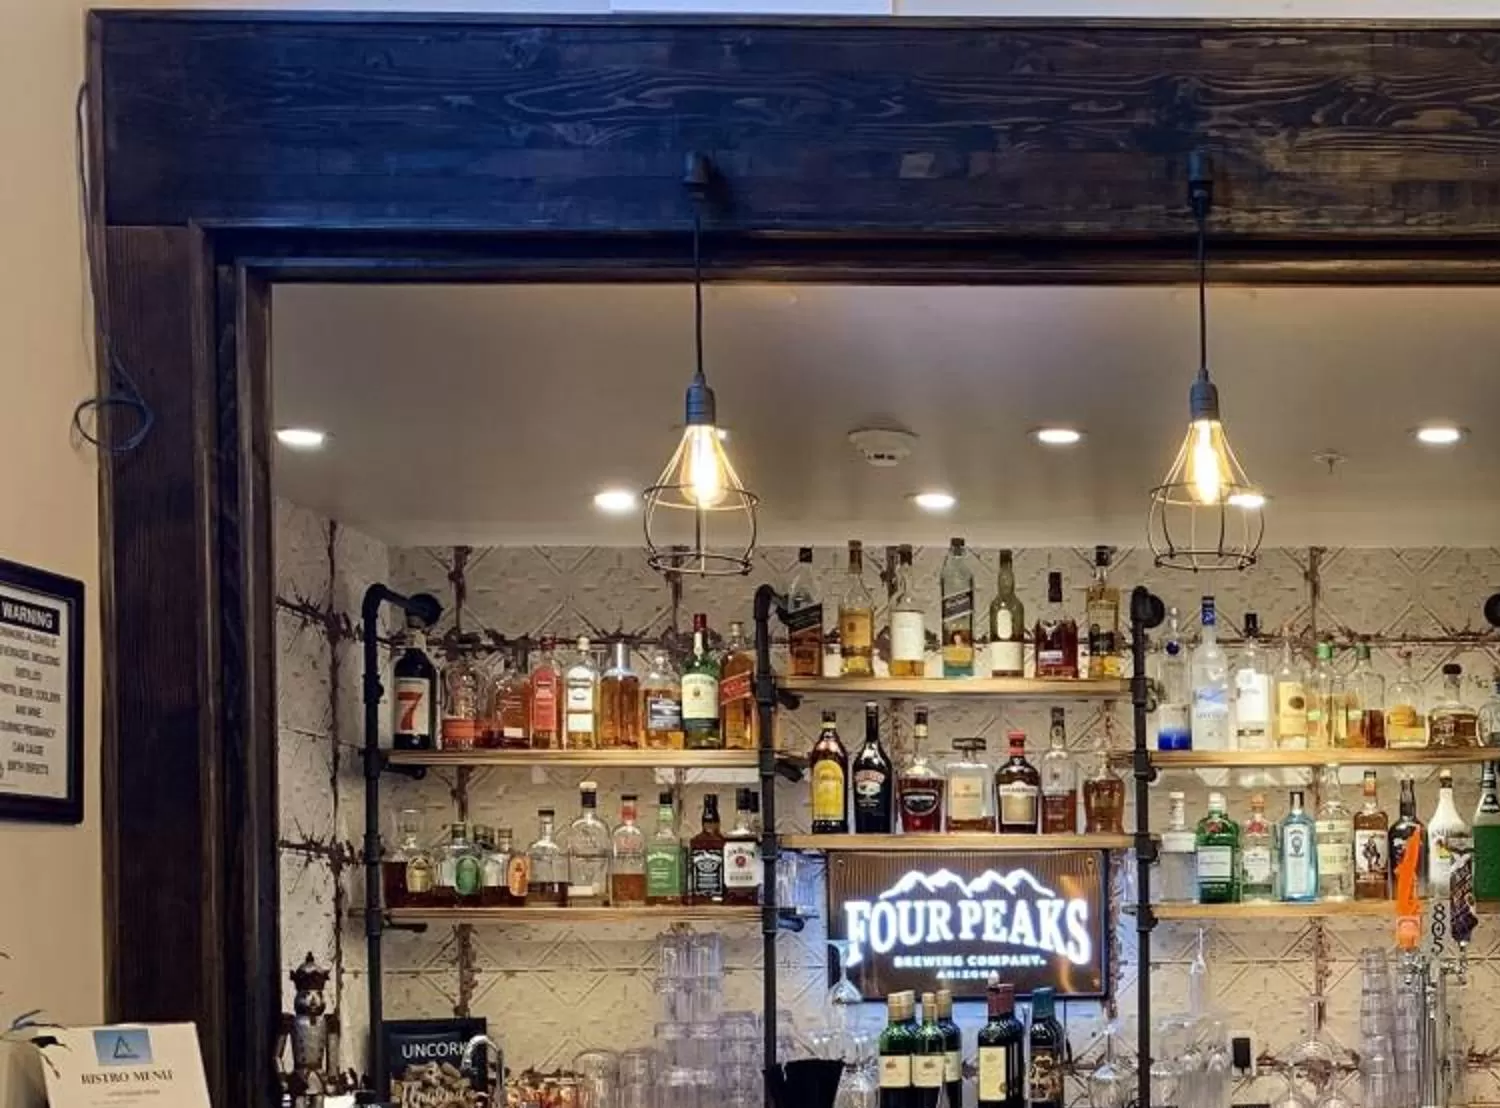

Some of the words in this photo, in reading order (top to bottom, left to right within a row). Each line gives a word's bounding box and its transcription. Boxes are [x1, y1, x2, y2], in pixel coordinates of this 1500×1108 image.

[1, 600, 53, 628] WARNING
[397, 691, 423, 730] 7
[844, 899, 952, 968] FOUR
[957, 897, 1092, 966] PEAKS
[893, 955, 964, 969] BREWING
